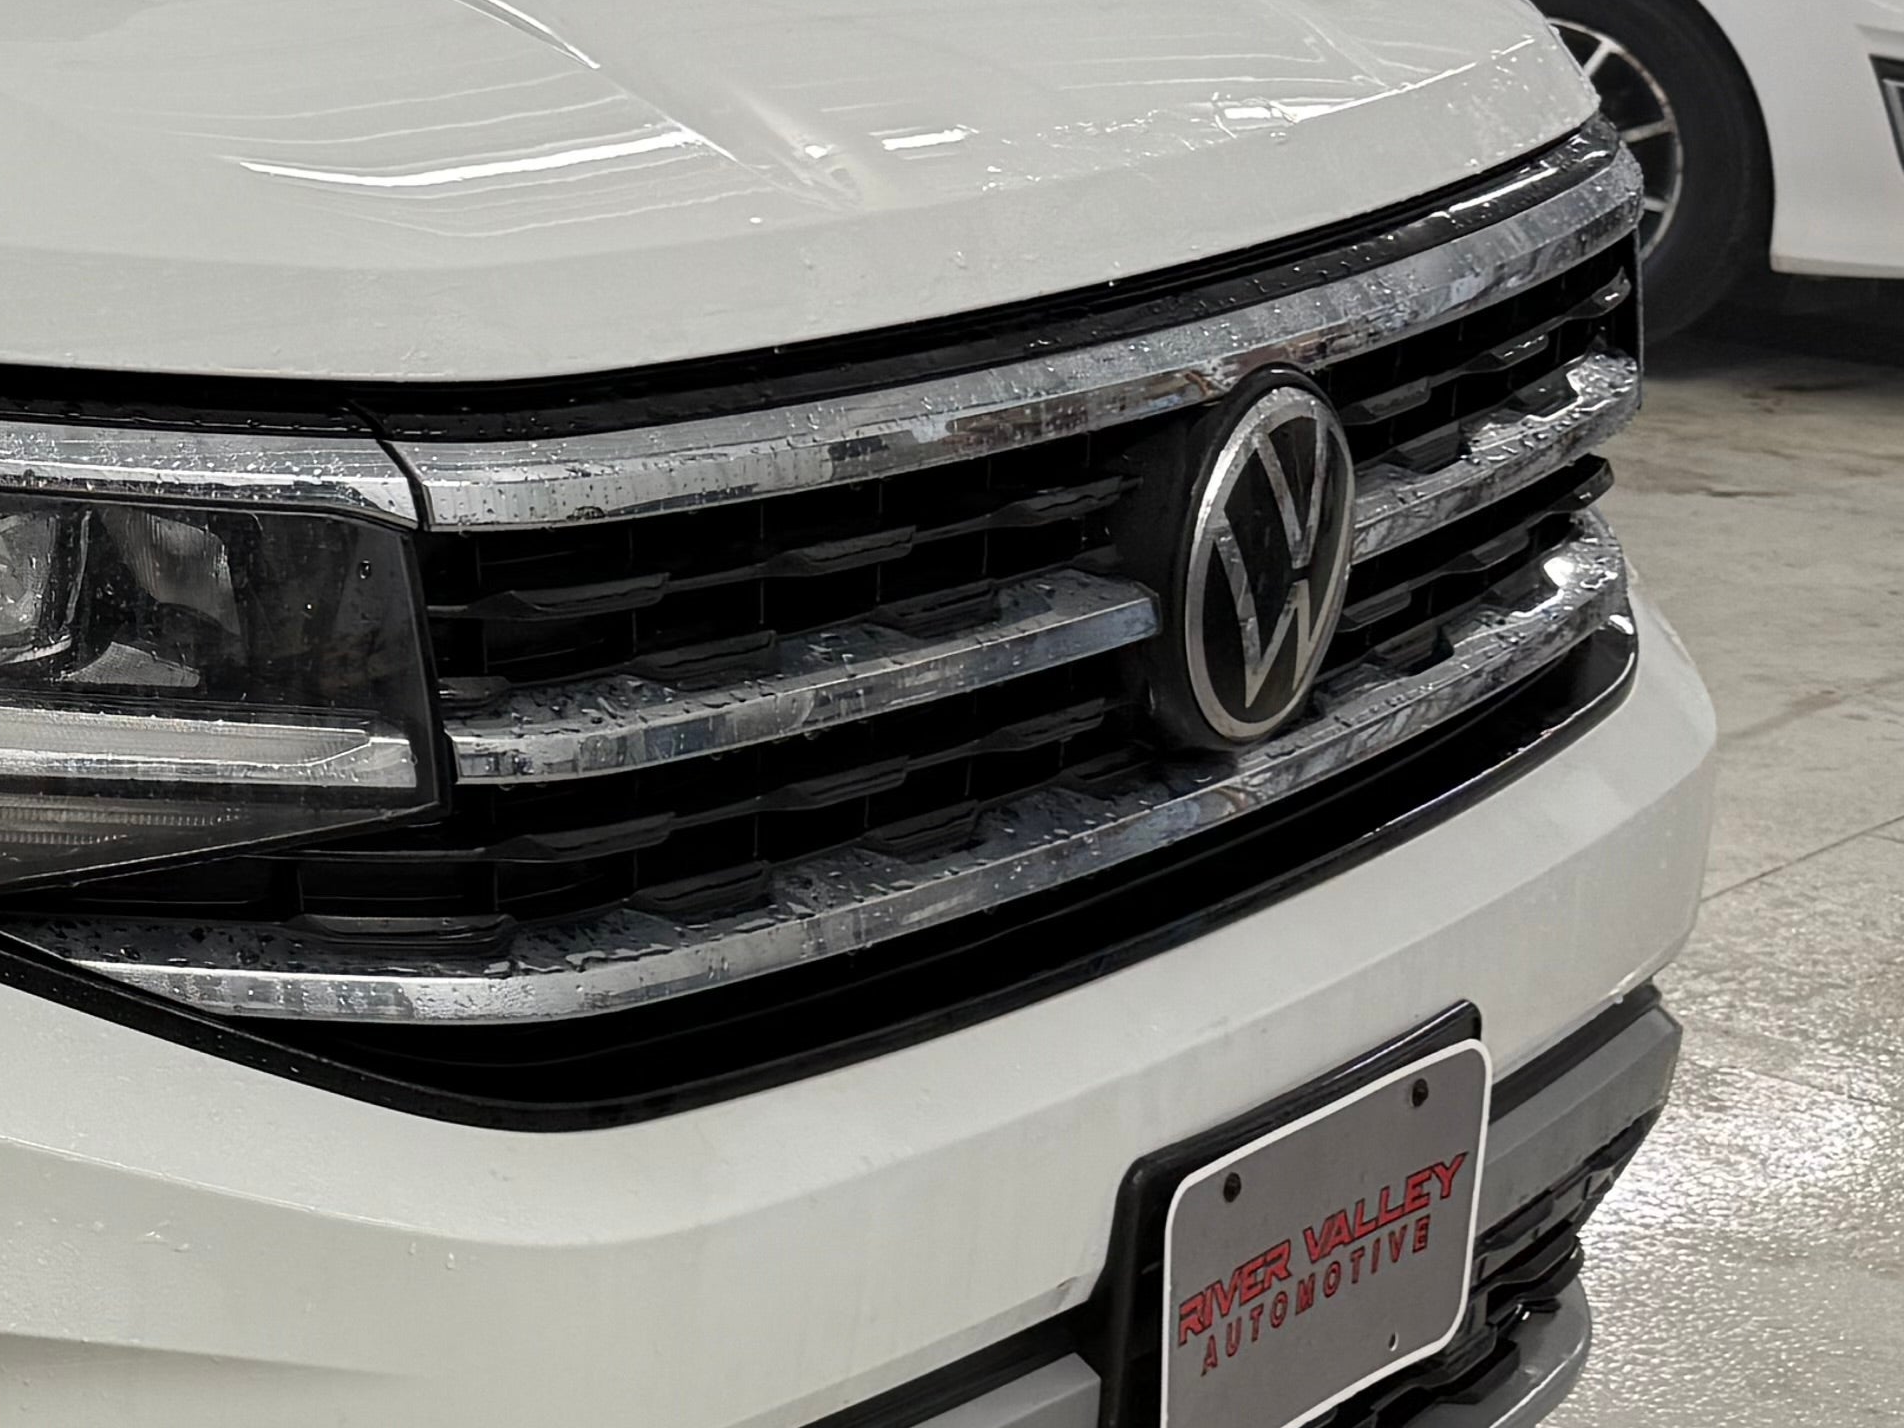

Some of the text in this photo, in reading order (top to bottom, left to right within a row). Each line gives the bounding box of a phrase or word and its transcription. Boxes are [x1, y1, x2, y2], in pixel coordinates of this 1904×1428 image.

[1177, 1151, 1470, 1347] RIVER VALLEY
[1201, 1214, 1432, 1376] AUTOMOTIVE
